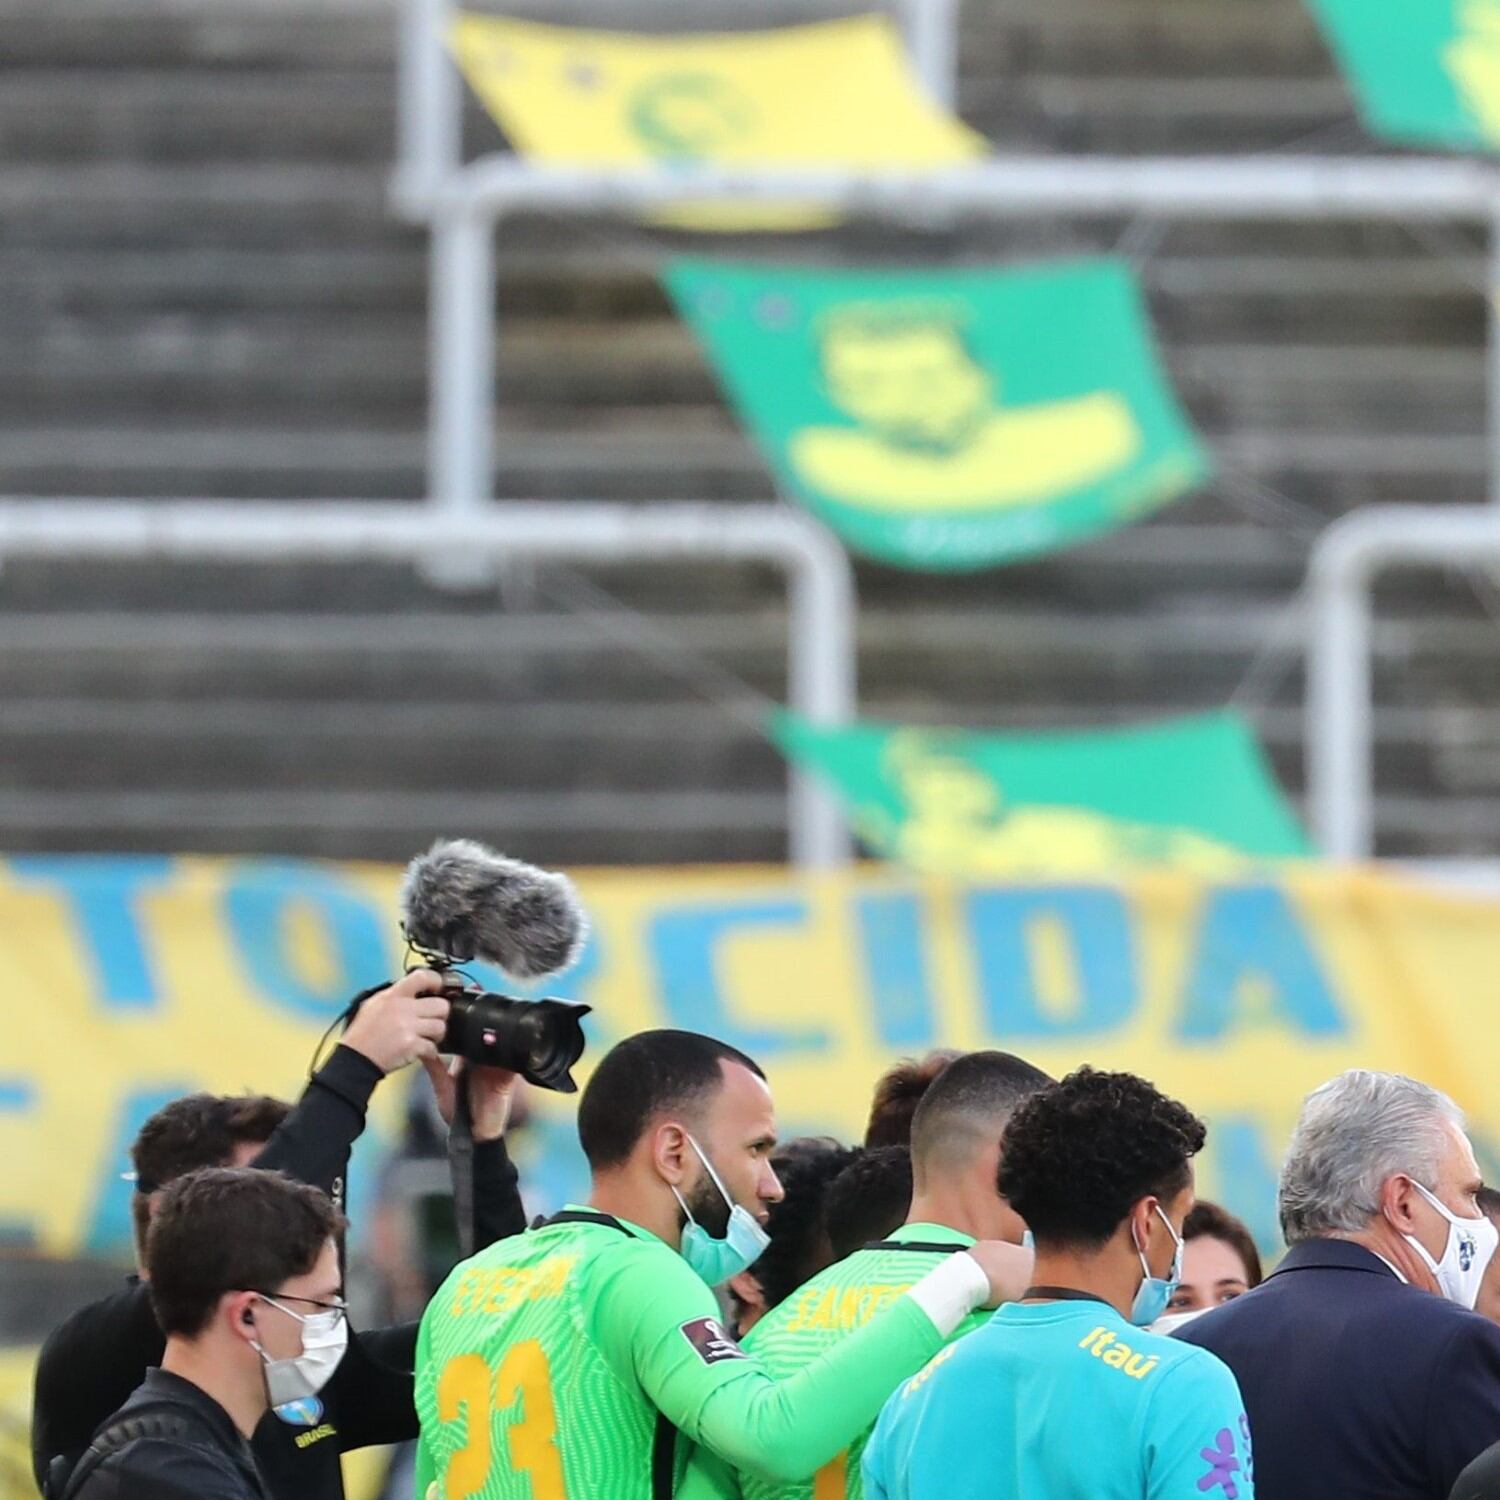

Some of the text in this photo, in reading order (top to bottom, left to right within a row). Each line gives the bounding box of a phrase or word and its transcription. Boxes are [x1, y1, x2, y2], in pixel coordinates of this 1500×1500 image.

[5, 852, 1350, 1050] TOCIDA
[1079, 1327, 1160, 1380] Itaú
[295, 1424, 338, 1449] BRASIL
